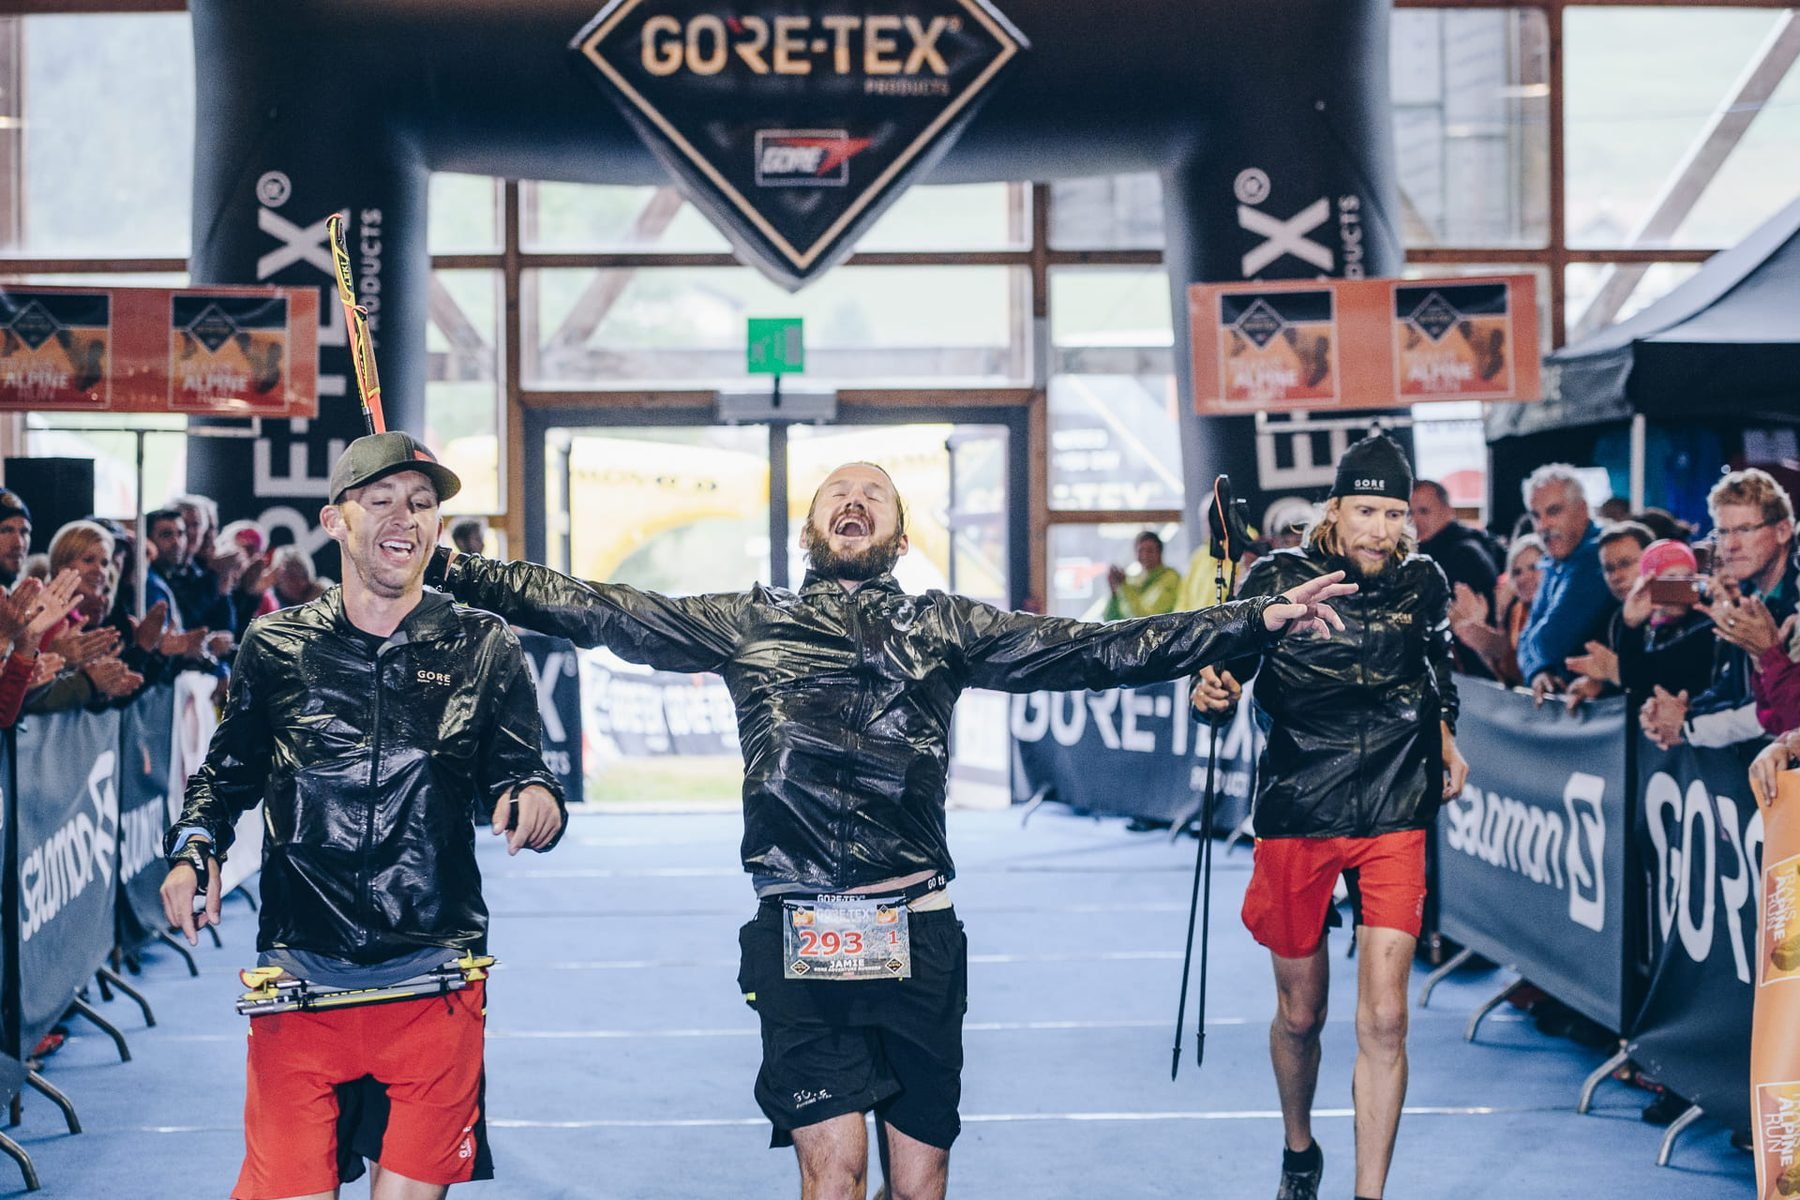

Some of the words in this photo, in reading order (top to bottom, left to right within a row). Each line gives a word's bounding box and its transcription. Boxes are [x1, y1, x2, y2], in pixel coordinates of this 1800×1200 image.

[1354, 479, 1385, 488] GORE
[417, 670, 451, 683] GORE
[1766, 892, 1778, 932] RUN
[1774, 876, 1787, 942] ALPINE
[799, 931, 864, 956] 293
[889, 931, 899, 944] 1
[1765, 1113, 1782, 1153] RUN
[1778, 1097, 1795, 1167] ALPINE
